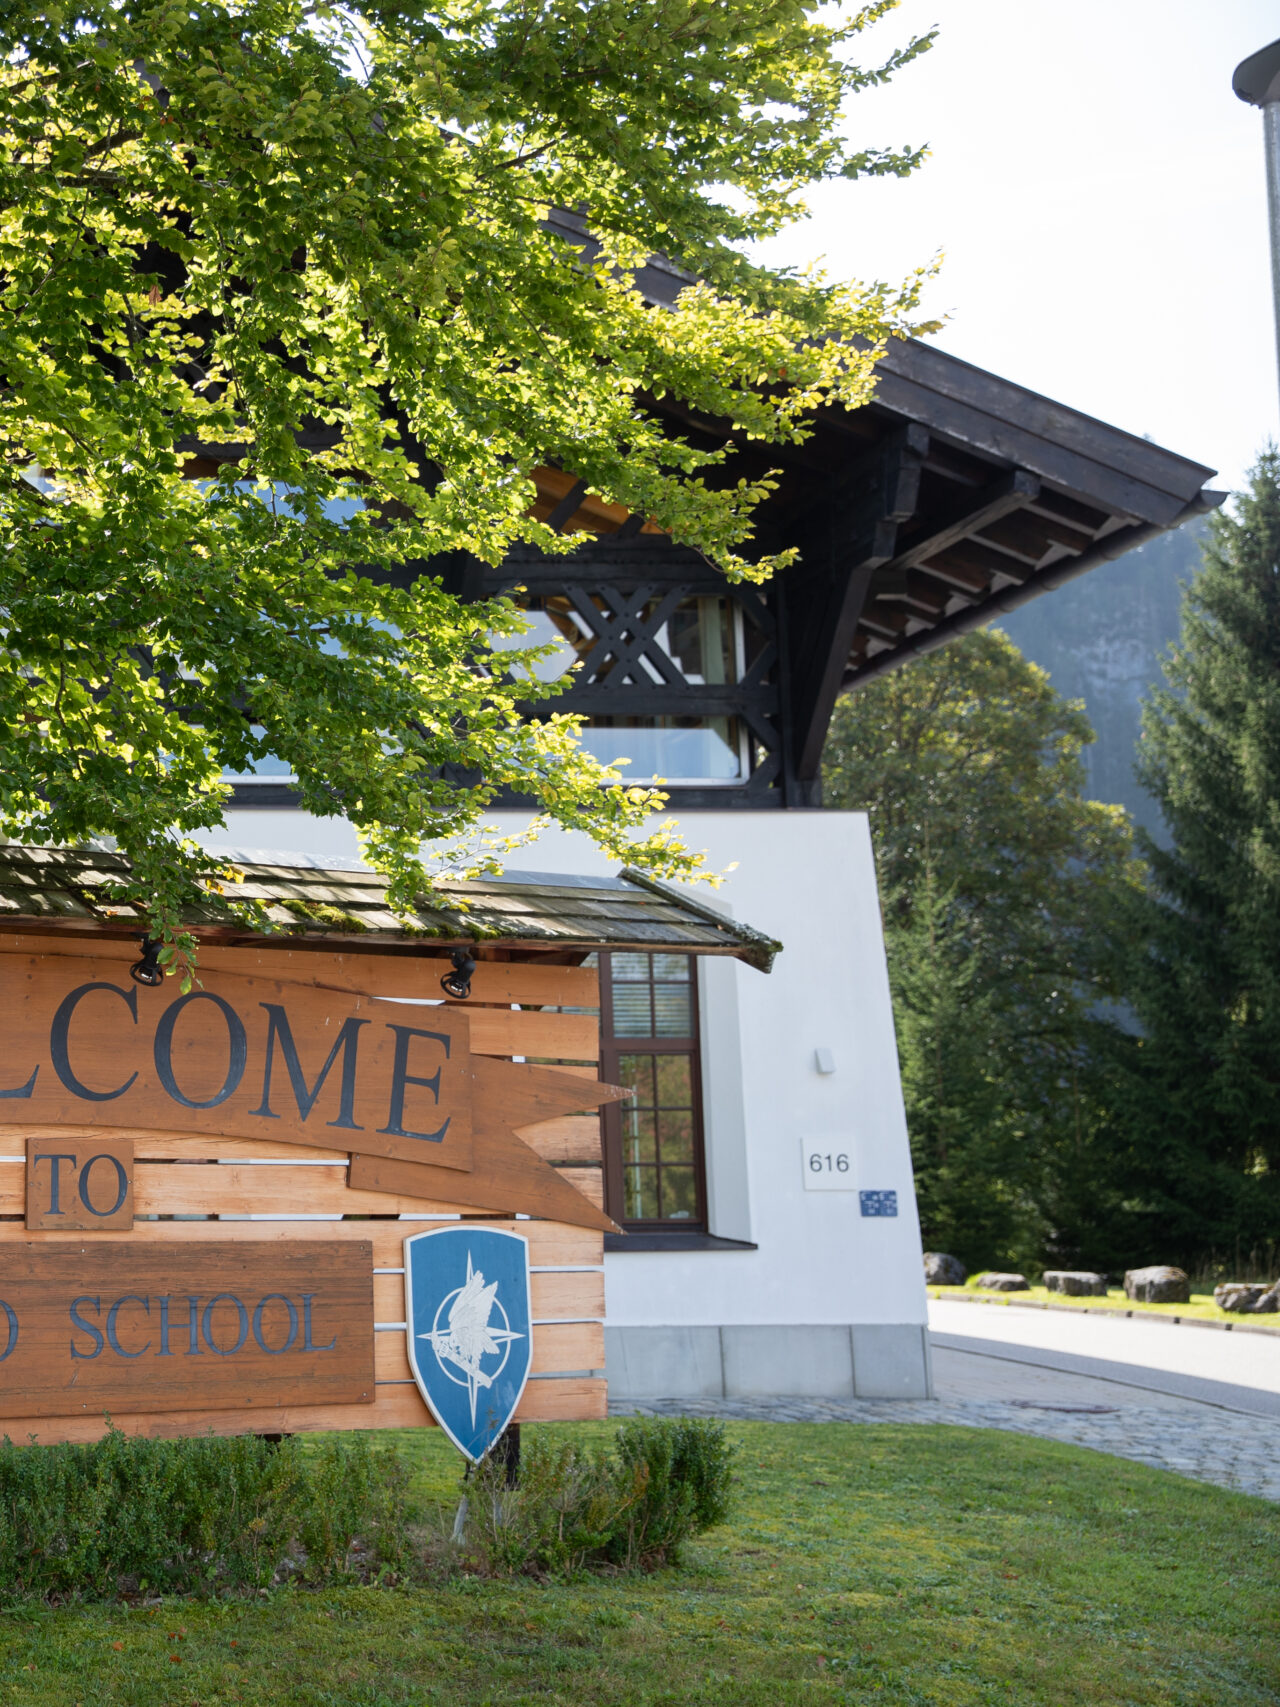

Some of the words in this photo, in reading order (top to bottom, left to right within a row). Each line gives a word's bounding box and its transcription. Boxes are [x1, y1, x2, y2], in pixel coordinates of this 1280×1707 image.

[34, 1154, 128, 1217] TO
[810, 1153, 849, 1172] 616
[70, 1292, 337, 1360] SCHOOL
